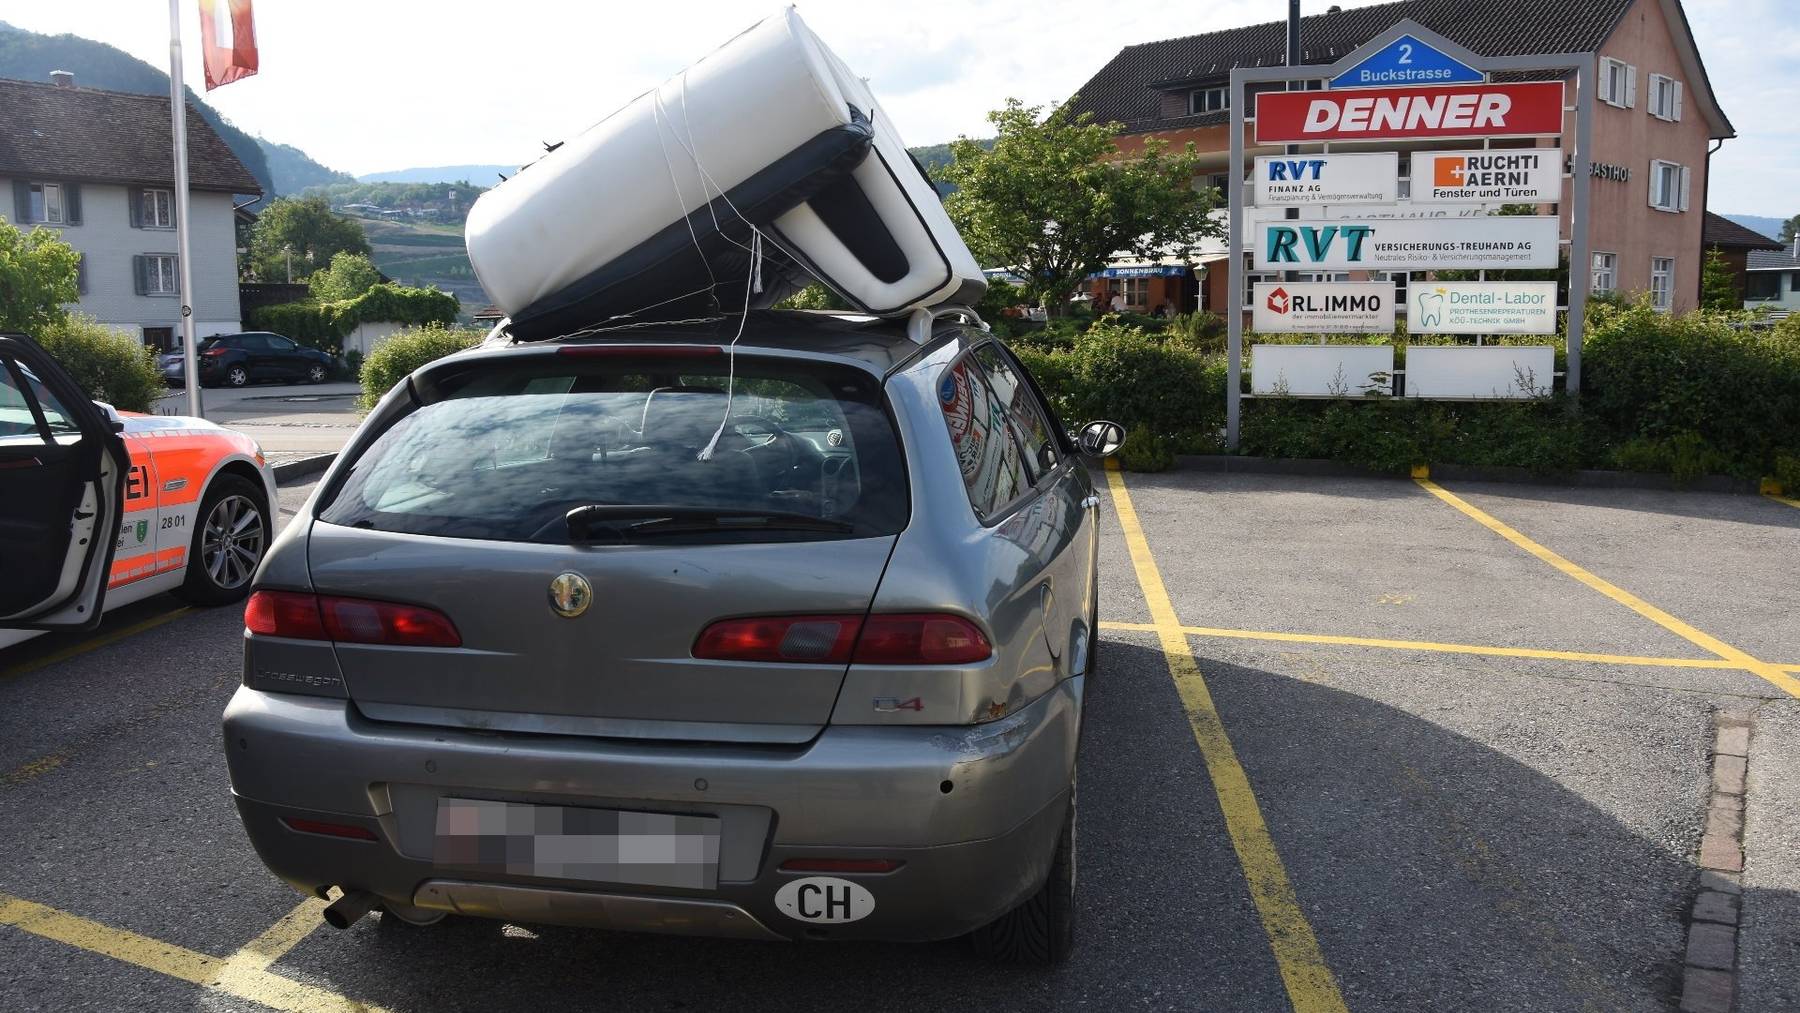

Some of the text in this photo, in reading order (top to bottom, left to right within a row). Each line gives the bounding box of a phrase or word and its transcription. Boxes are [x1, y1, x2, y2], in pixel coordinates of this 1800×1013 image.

[1398, 44, 1412, 64] 2
[1361, 68, 1452, 82] Buckstrasse
[1302, 93, 1512, 133] DENNER
[1467, 155, 1538, 170] RUCHTI
[1268, 160, 1327, 181] RVT
[1466, 172, 1528, 186] AERNI
[1268, 185, 1304, 193] FINANZ
[1433, 187, 1537, 198] Fenster und Türen
[1268, 194, 1310, 202] Finanzplanung
[1318, 193, 1383, 201] Vermögensverwaltung
[1267, 225, 1376, 262] RVT
[1374, 241, 1532, 251] VERSICHERUNGS-TREUHAND AG
[1375, 253, 1406, 261] Neutrales
[1439, 253, 1531, 262] Versicherungsmanagement
[1292, 295, 1380, 311] RL.IMMO
[1450, 291, 1495, 304] Dental
[1505, 291, 1546, 304] Labor
[798, 883, 851, 919] CH
